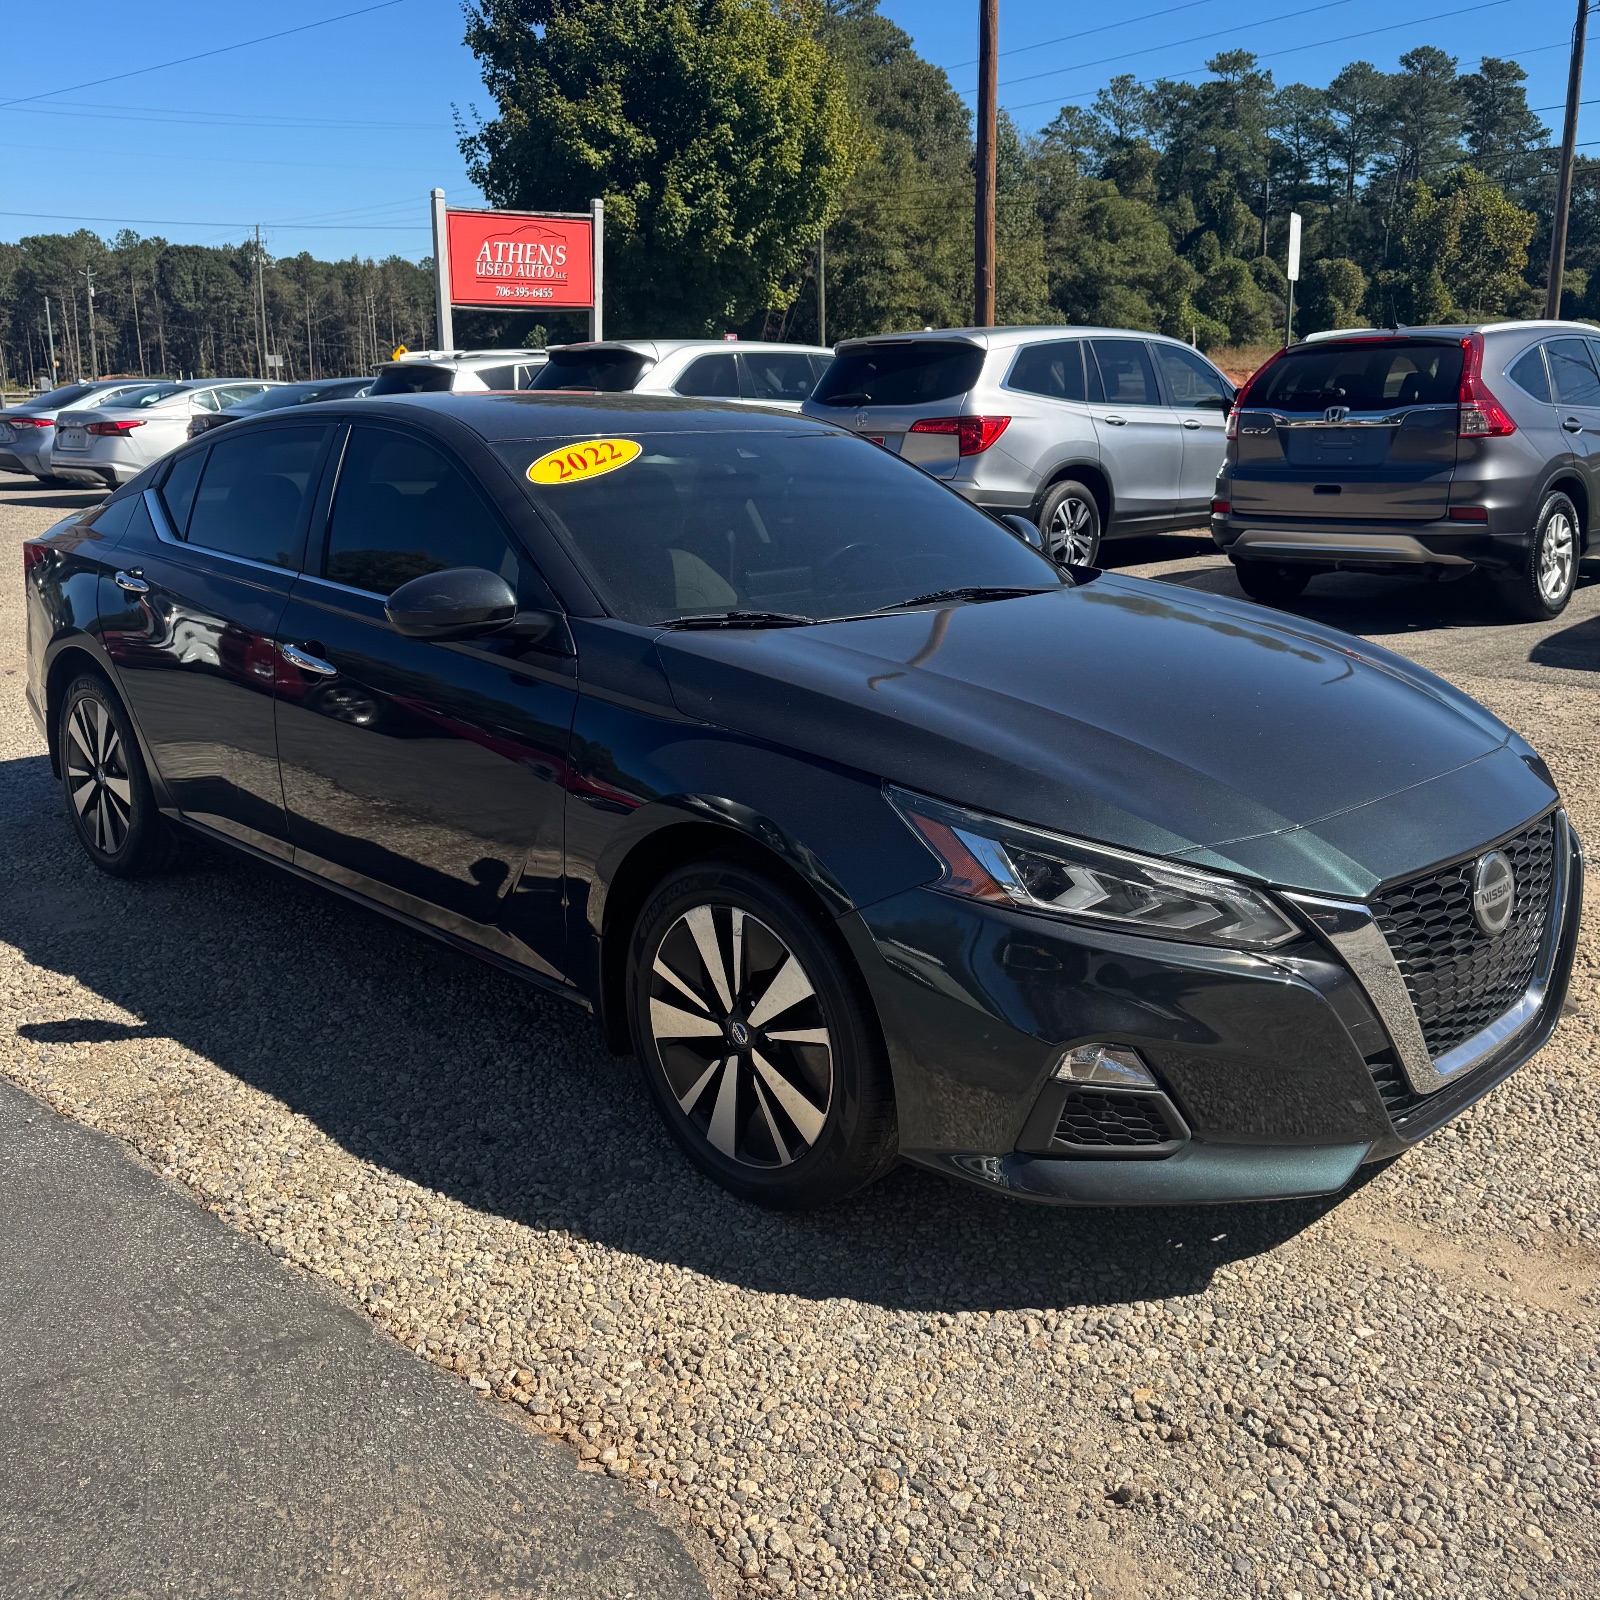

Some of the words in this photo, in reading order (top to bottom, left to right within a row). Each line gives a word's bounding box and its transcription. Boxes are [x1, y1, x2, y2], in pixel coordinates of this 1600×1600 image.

[476, 241, 567, 266] ATHENS
[476, 262, 512, 277] USED
[516, 264, 555, 279] AUTO
[495, 286, 553, 298] 706-395-6455
[549, 442, 622, 479] 2022
[1481, 881, 1512, 905] NISSAN
